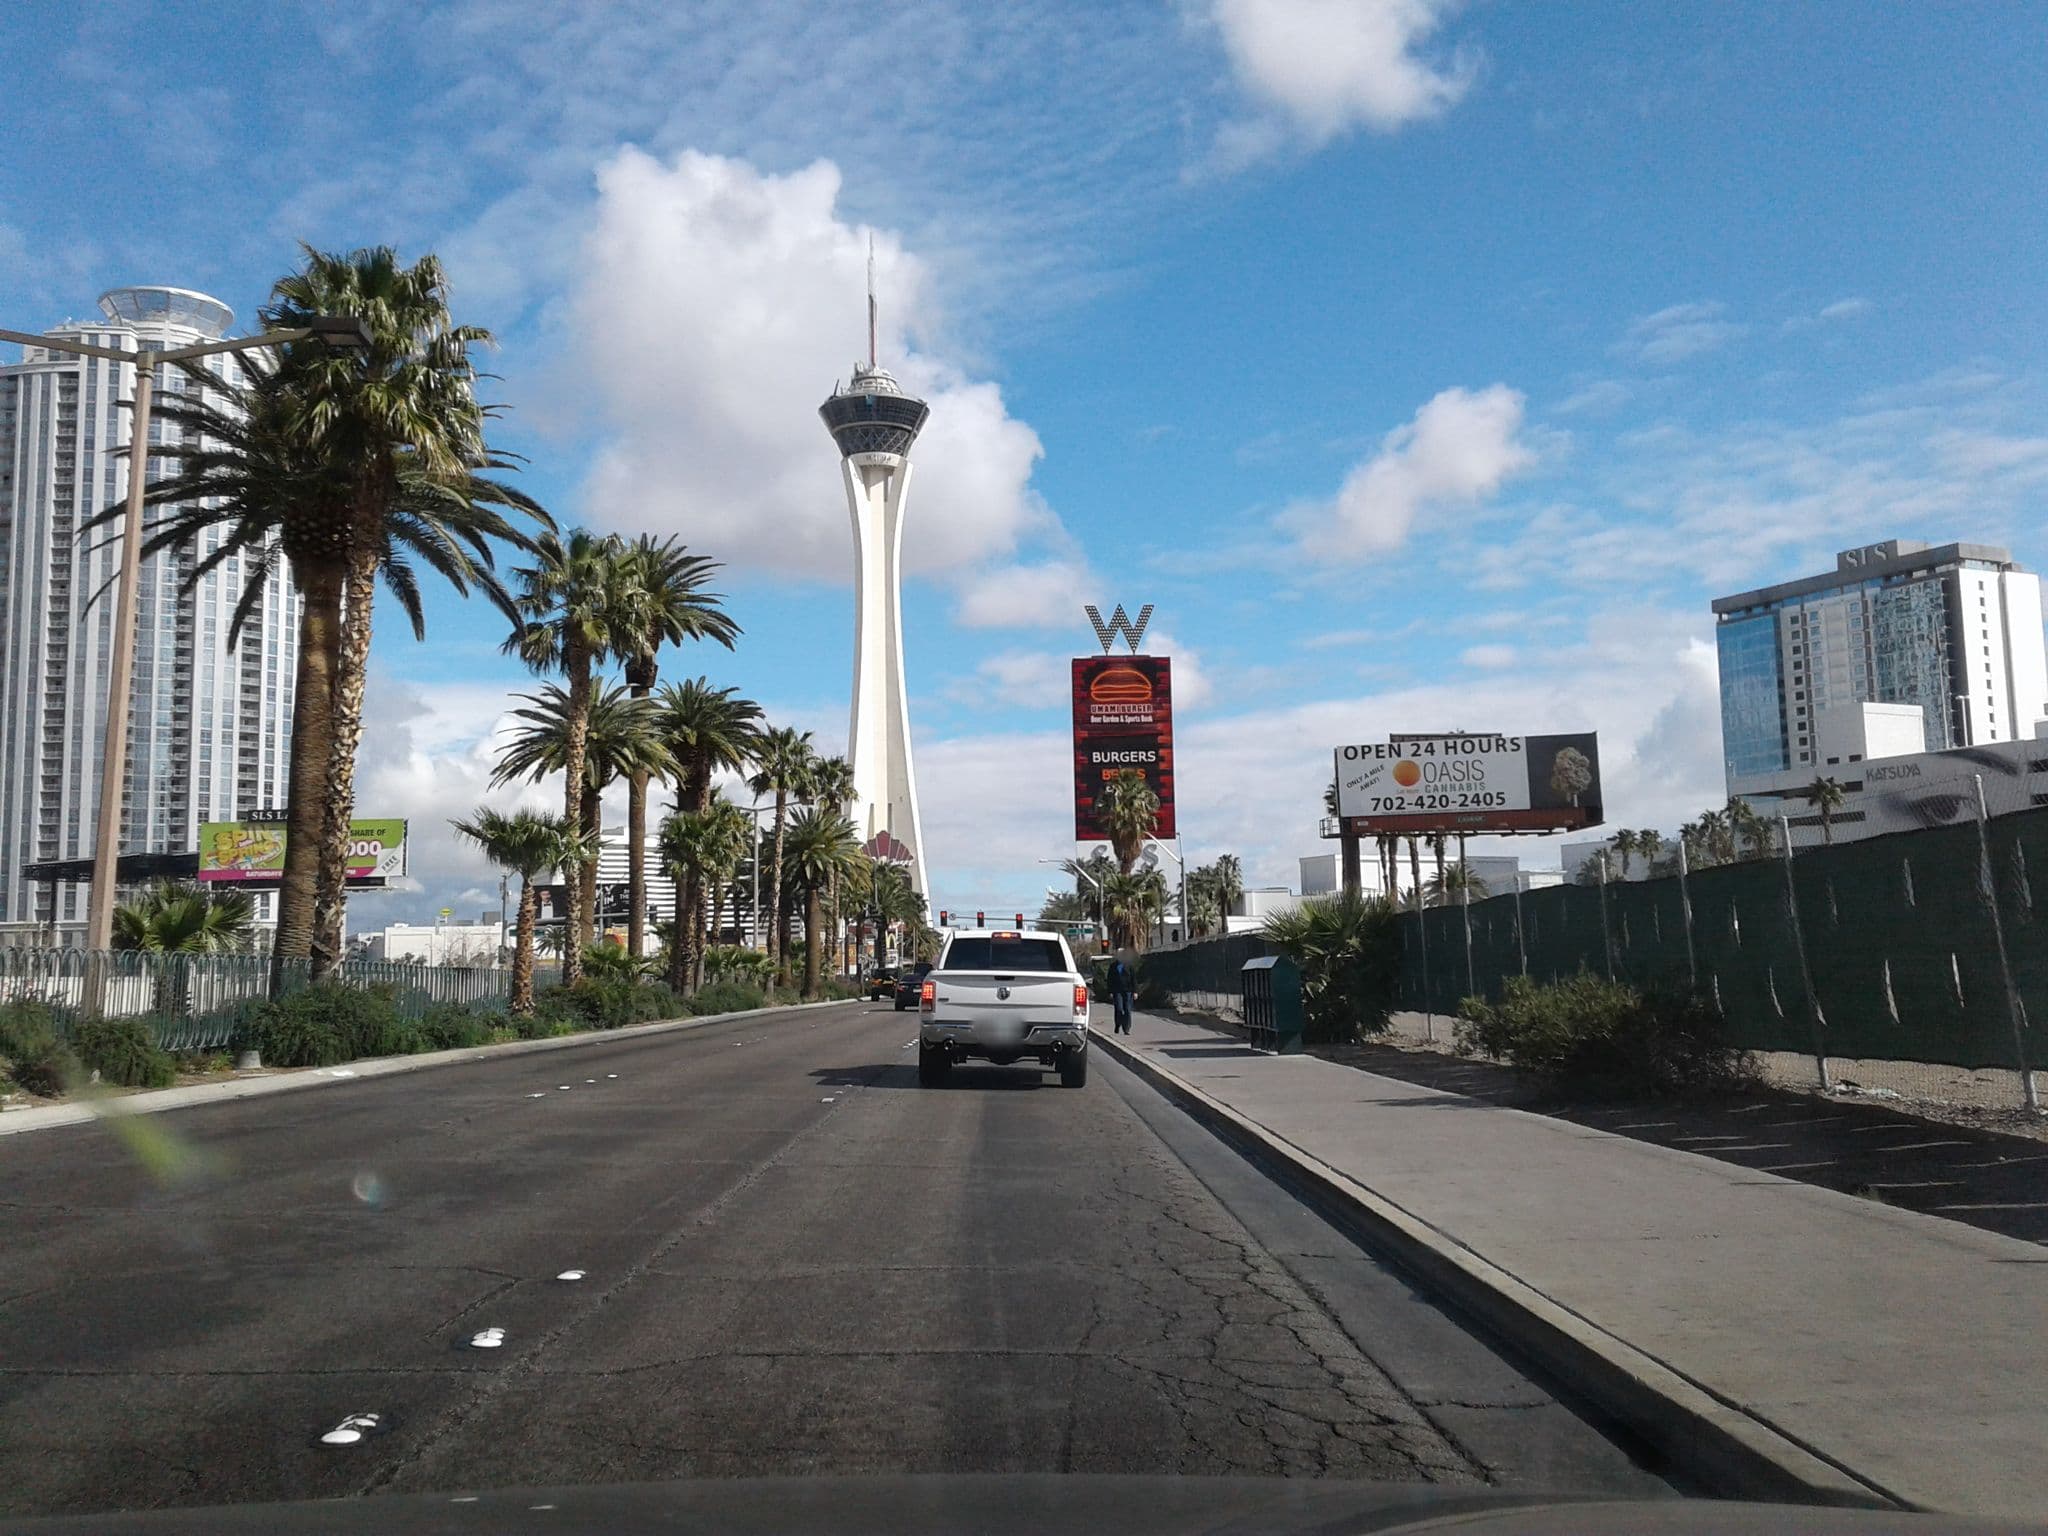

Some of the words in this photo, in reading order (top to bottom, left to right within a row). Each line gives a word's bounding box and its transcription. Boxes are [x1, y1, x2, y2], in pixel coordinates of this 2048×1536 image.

[1845, 544, 1887, 567] SLS
[1084, 603, 1155, 656] W
[1092, 750, 1156, 763] BURGERS
[1343, 744, 1402, 760] OPEN
[1410, 742, 1436, 757] 24
[1444, 737, 1521, 756] HOURS
[1102, 768, 1146, 781] BES
[1424, 759, 1485, 783] OASIS
[1866, 763, 1921, 781] KATSUYA
[1346, 774, 1363, 788] ONLY
[1424, 782, 1486, 794] CANNABIS
[1370, 791, 1506, 812] 702-420-2405
[252, 812, 273, 820] SLS
[376, 828, 387, 836] OF
[380, 855, 398, 871] FREE
